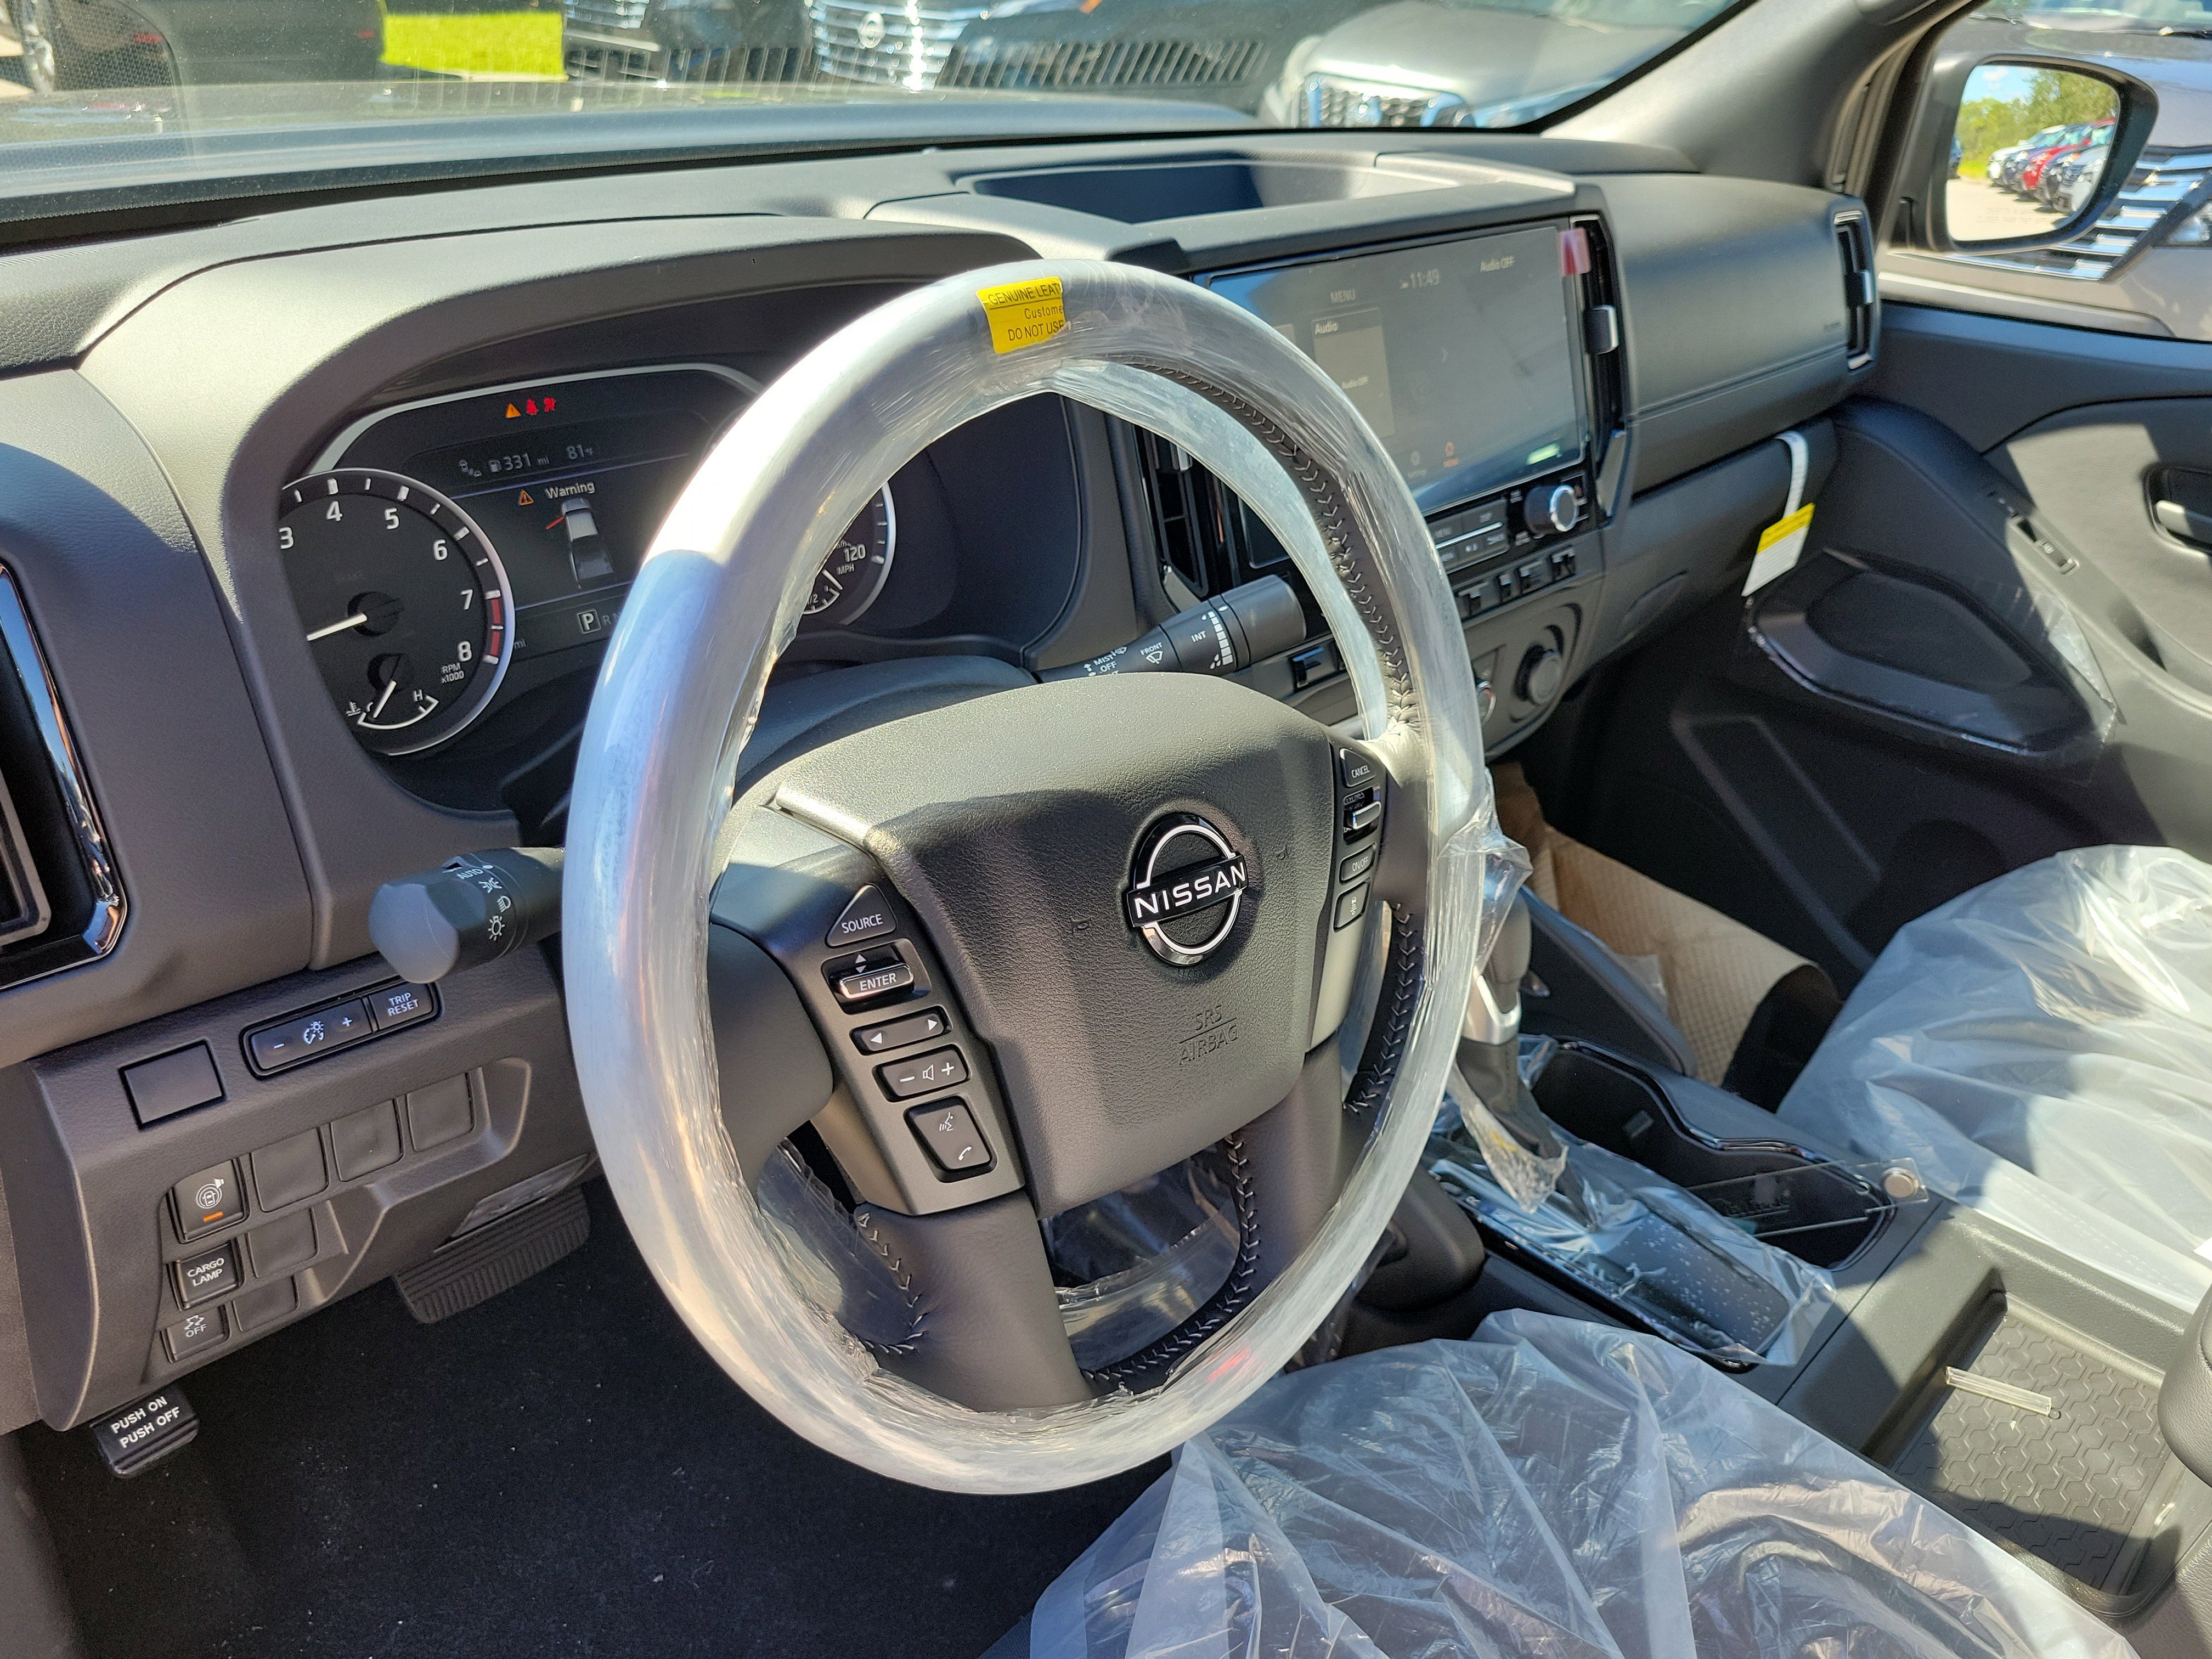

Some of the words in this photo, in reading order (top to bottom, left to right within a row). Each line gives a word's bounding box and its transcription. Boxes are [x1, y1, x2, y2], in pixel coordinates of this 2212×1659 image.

[988, 287, 1035, 304] GENUINE
[1330, 290, 1356, 303] MENU
[1008, 328, 1023, 341] DO
[1025, 324, 1043, 338] NOT
[1314, 321, 1339, 336] Audio
[503, 453, 531, 471] 331
[545, 481, 595, 500] Warning
[326, 501, 343, 522] 4
[385, 507, 400, 530] 5
[279, 526, 294, 549] 3
[433, 539, 448, 561] 6
[844, 543, 866, 562] 120
[836, 563, 855, 575] MPH
[461, 589, 473, 611] 7
[582, 612, 594, 630] P
[602, 615, 612, 626] R
[1191, 631, 1206, 642] INT
[458, 641, 472, 663] 8
[1140, 642, 1163, 656] FRONT
[441, 662, 461, 674] RPM
[1093, 653, 1114, 666] MIST
[1100, 661, 1117, 673] OFF
[441, 670, 465, 684] x1000
[413, 689, 424, 702] H
[1351, 765, 1370, 778] CANCEL
[1352, 856, 1368, 872] ON/OFF
[456, 868, 483, 880] AUTO
[1133, 861, 1246, 919] NISSAN
[841, 913, 883, 934] SOURCE
[860, 973, 897, 991] ENTER
[387, 999, 419, 1017] RESET
[389, 992, 412, 1006] TRIP
[1195, 1005, 1223, 1031] SRS
[1178, 1024, 1239, 1065] AIRBAG
[187, 1257, 225, 1278] CARGO
[193, 1268, 223, 1287] LAMP
[185, 1323, 207, 1338] OFF
[111, 1408, 146, 1434] PUSH
[148, 1396, 168, 1412] ON
[119, 1422, 155, 1448] PUSH
[156, 1406, 180, 1426] OFF
